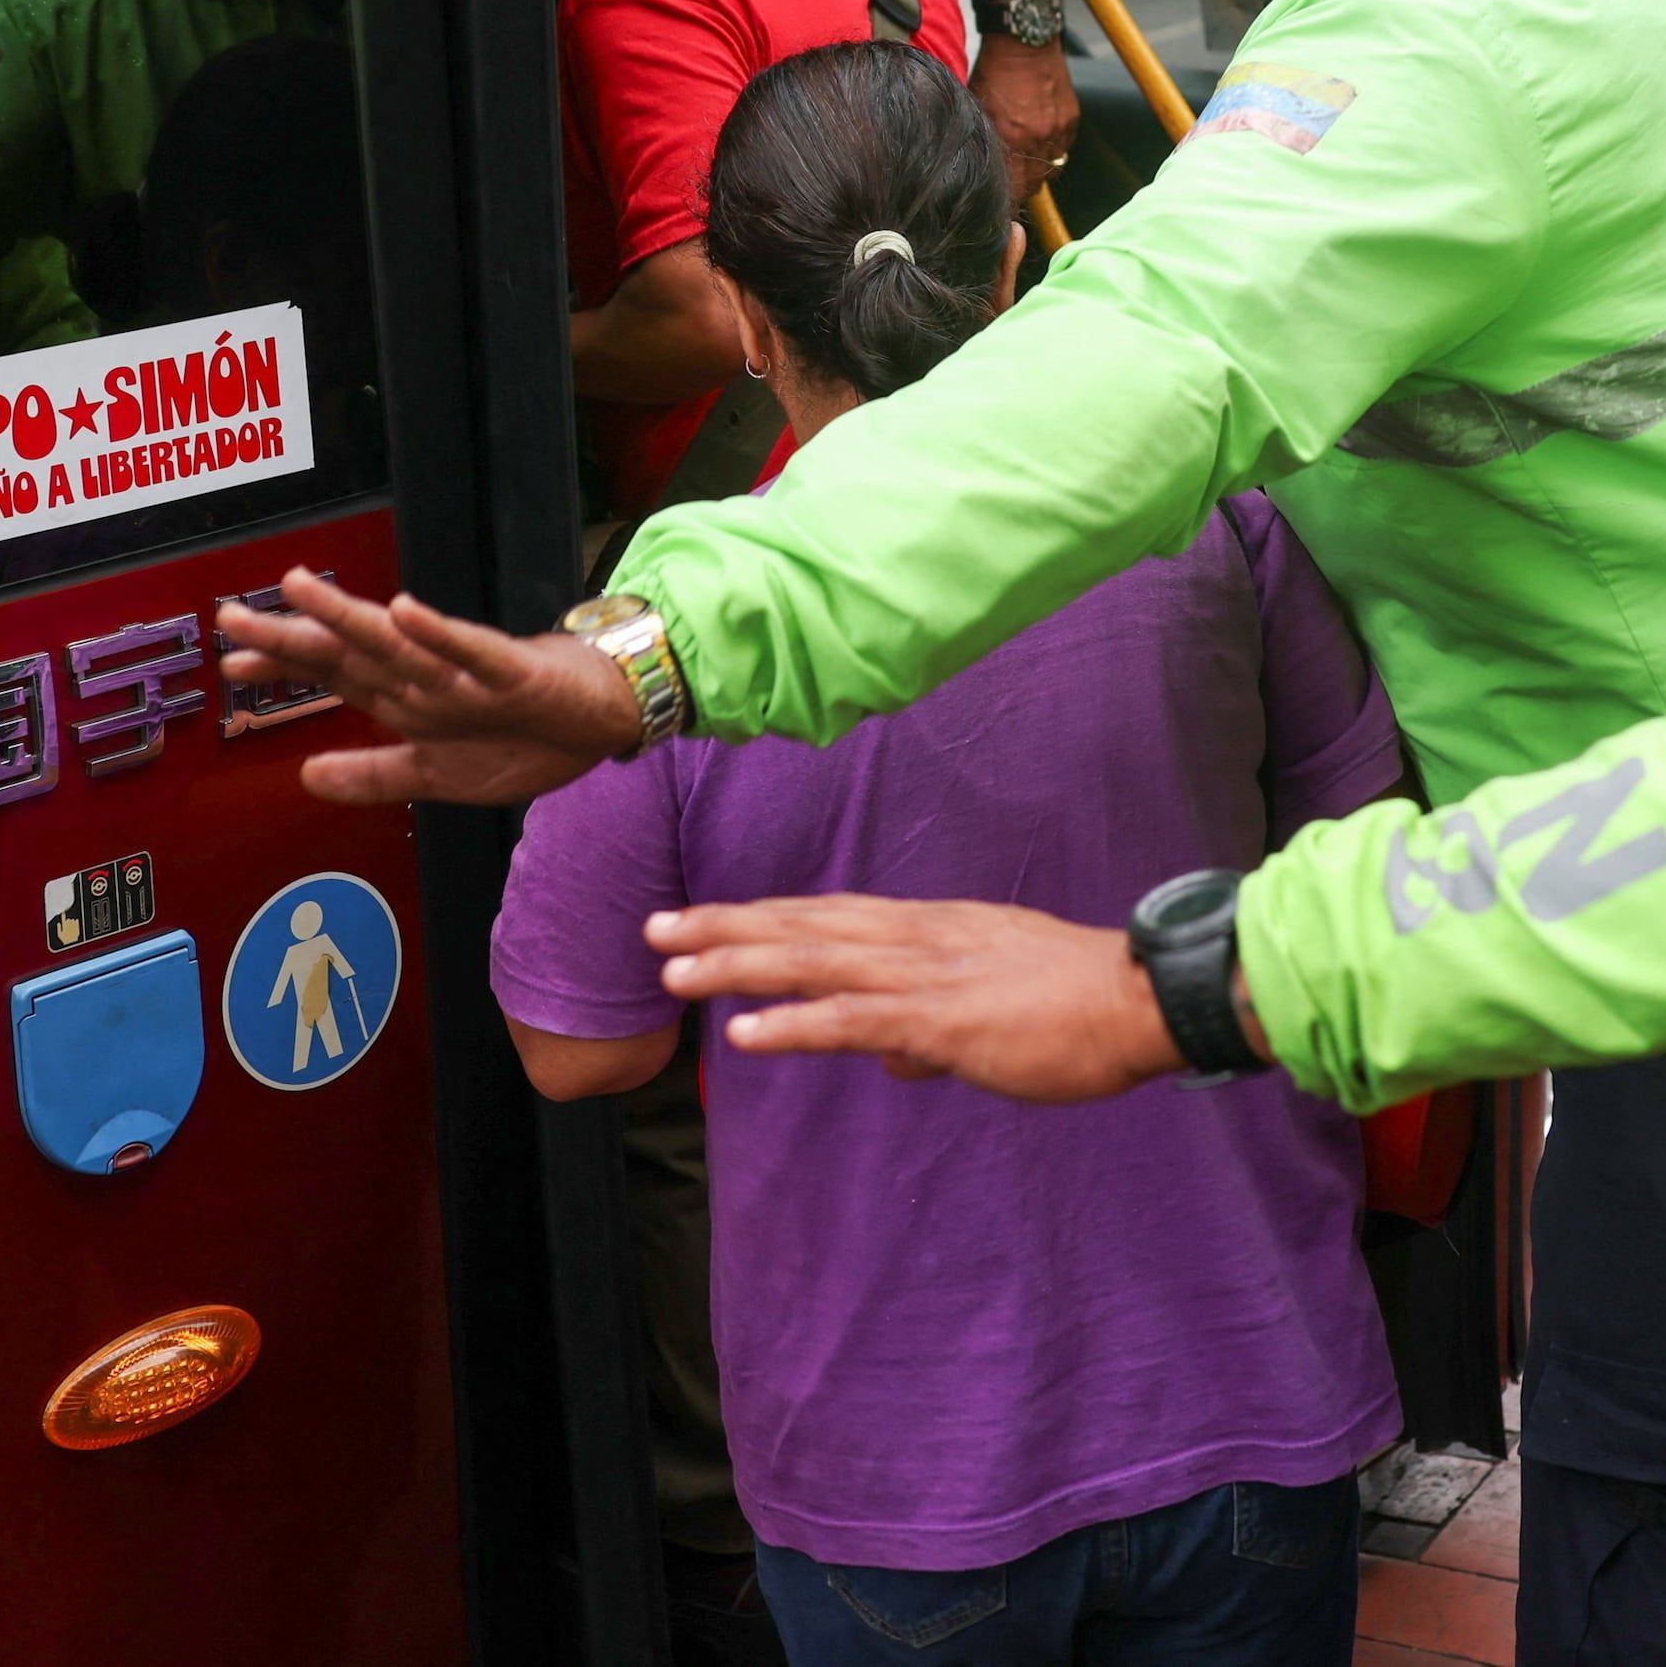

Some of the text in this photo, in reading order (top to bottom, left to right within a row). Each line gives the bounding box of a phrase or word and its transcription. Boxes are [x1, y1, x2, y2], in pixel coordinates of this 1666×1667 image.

[102, 329, 282, 445] SIMÓN
[47, 463, 76, 510] A
[80, 415, 285, 500] LIBERTADOR
